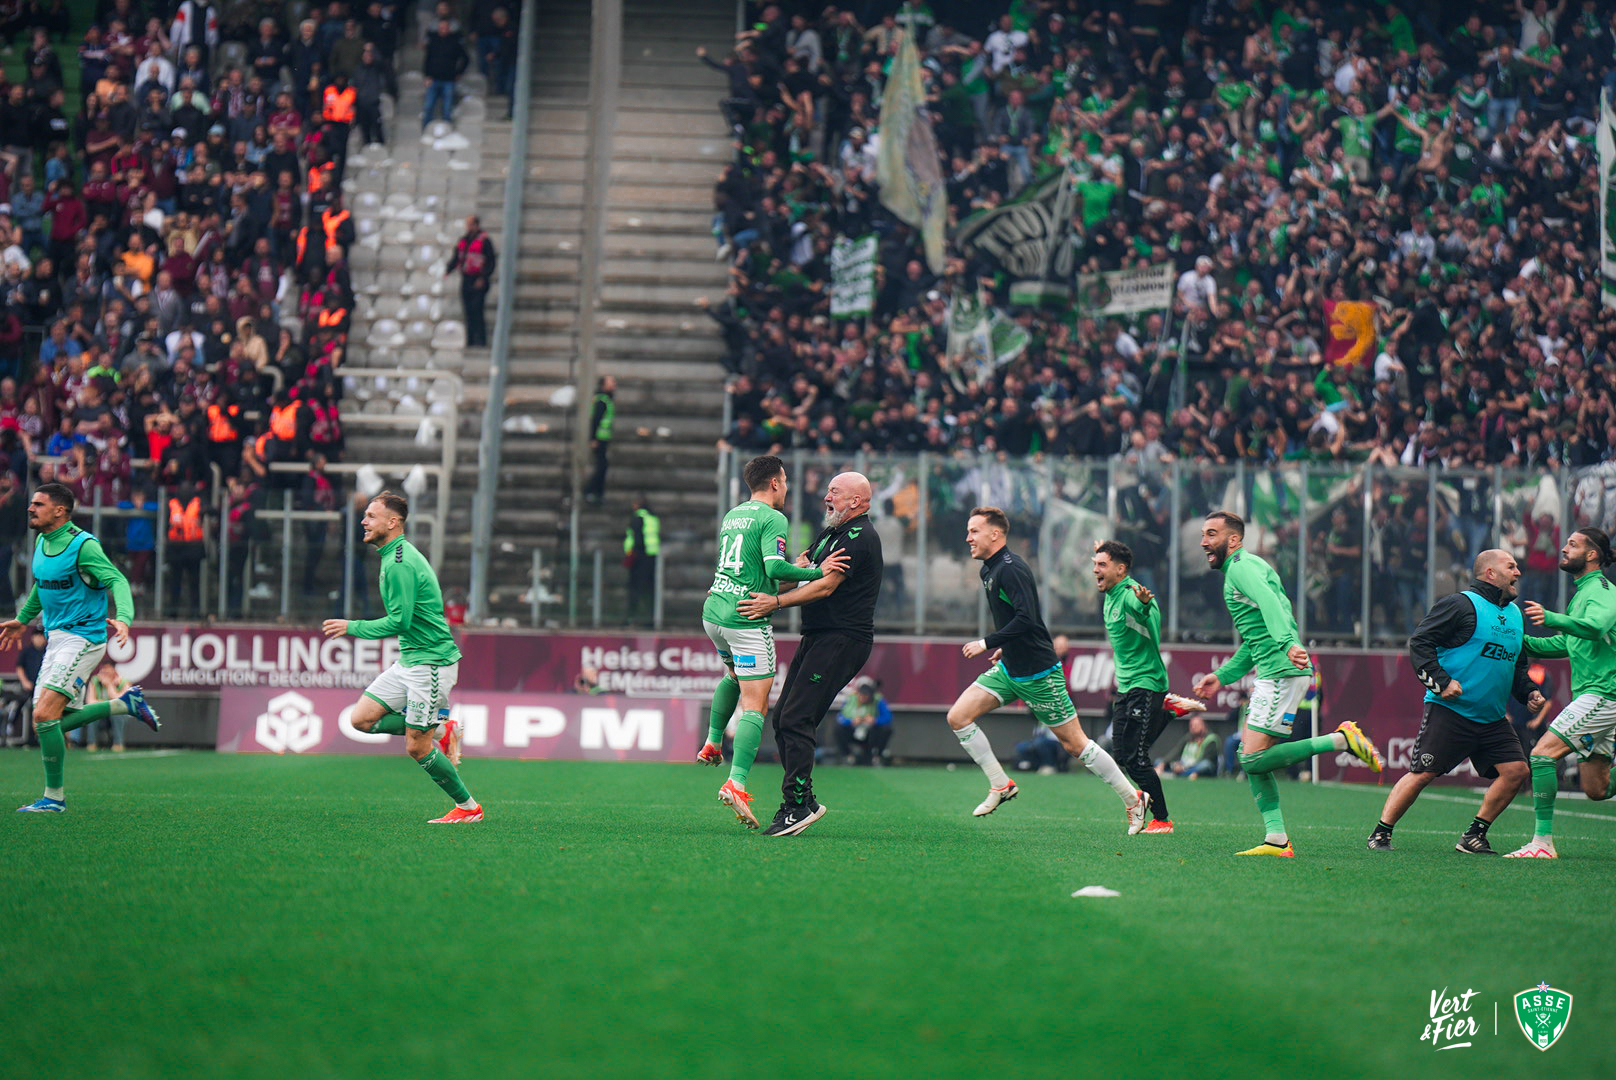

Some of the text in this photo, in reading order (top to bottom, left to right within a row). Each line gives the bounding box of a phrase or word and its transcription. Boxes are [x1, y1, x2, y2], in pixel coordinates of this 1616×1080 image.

[718, 533, 744, 575] 14
[581, 646, 659, 671] Heiss
[1481, 641, 1516, 663] ZEbet
